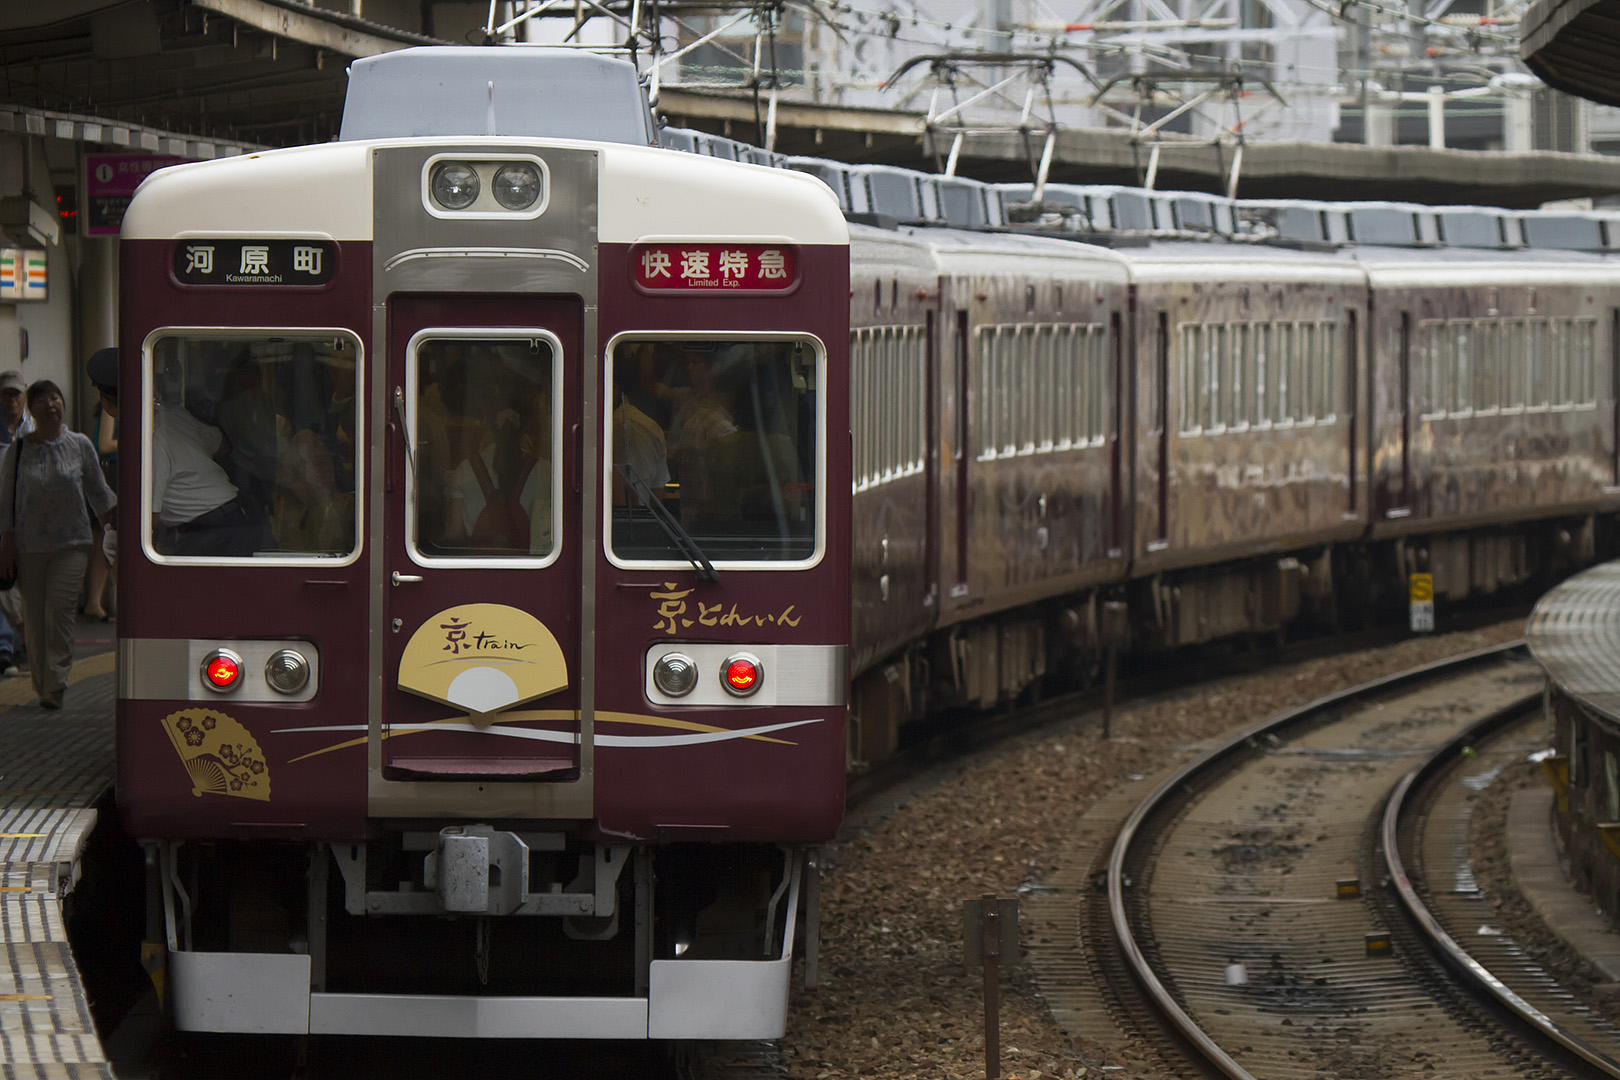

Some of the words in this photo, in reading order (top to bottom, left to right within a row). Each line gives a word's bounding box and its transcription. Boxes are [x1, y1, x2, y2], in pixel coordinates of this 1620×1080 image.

[185, 245, 324, 275] 河原町
[641, 250, 787, 279] 快速特急
[226, 274, 283, 283] Kawaramachi
[688, 278, 719, 287] Limited
[723, 279, 741, 288] Exp.
[649, 581, 802, 635] 京とれいん
